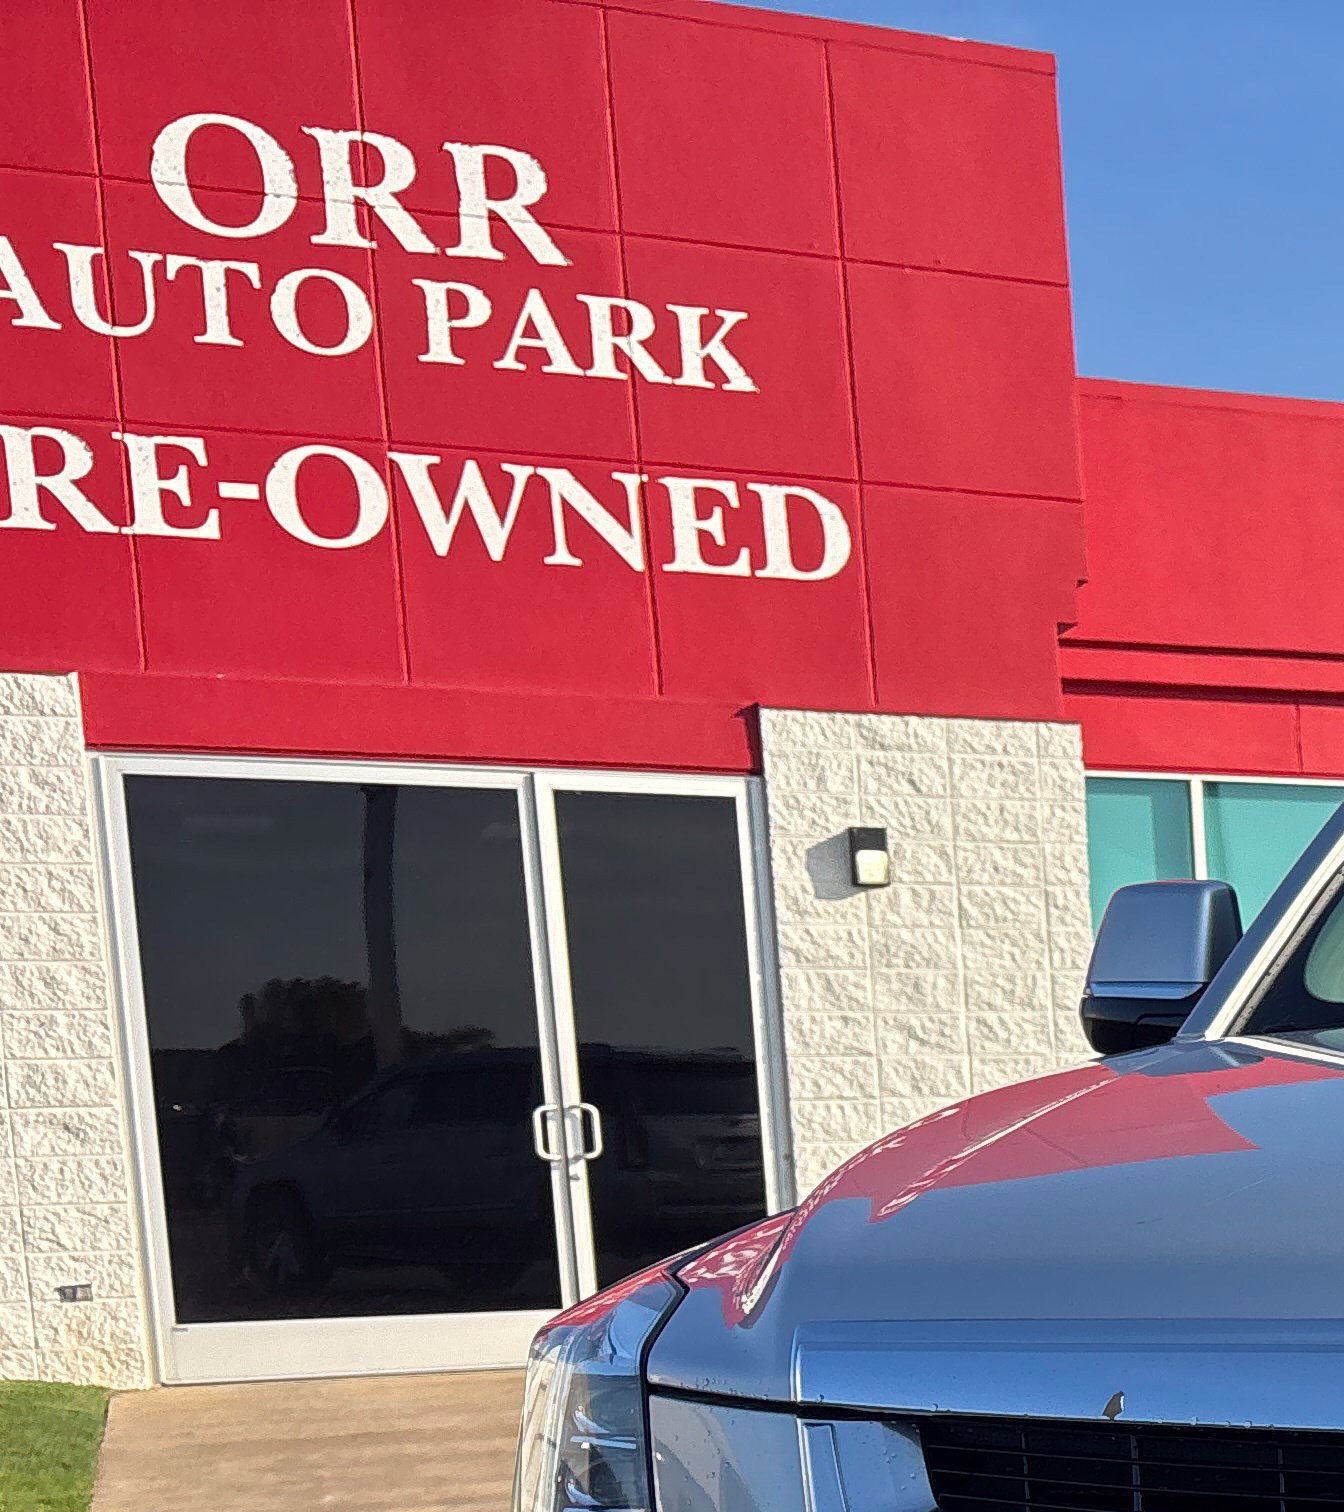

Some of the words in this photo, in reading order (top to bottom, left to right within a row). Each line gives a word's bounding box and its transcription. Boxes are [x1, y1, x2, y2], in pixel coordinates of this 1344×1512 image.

[150, 113, 572, 267] ORR
[0, 235, 374, 356] AUTO
[411, 278, 760, 393] PARK
